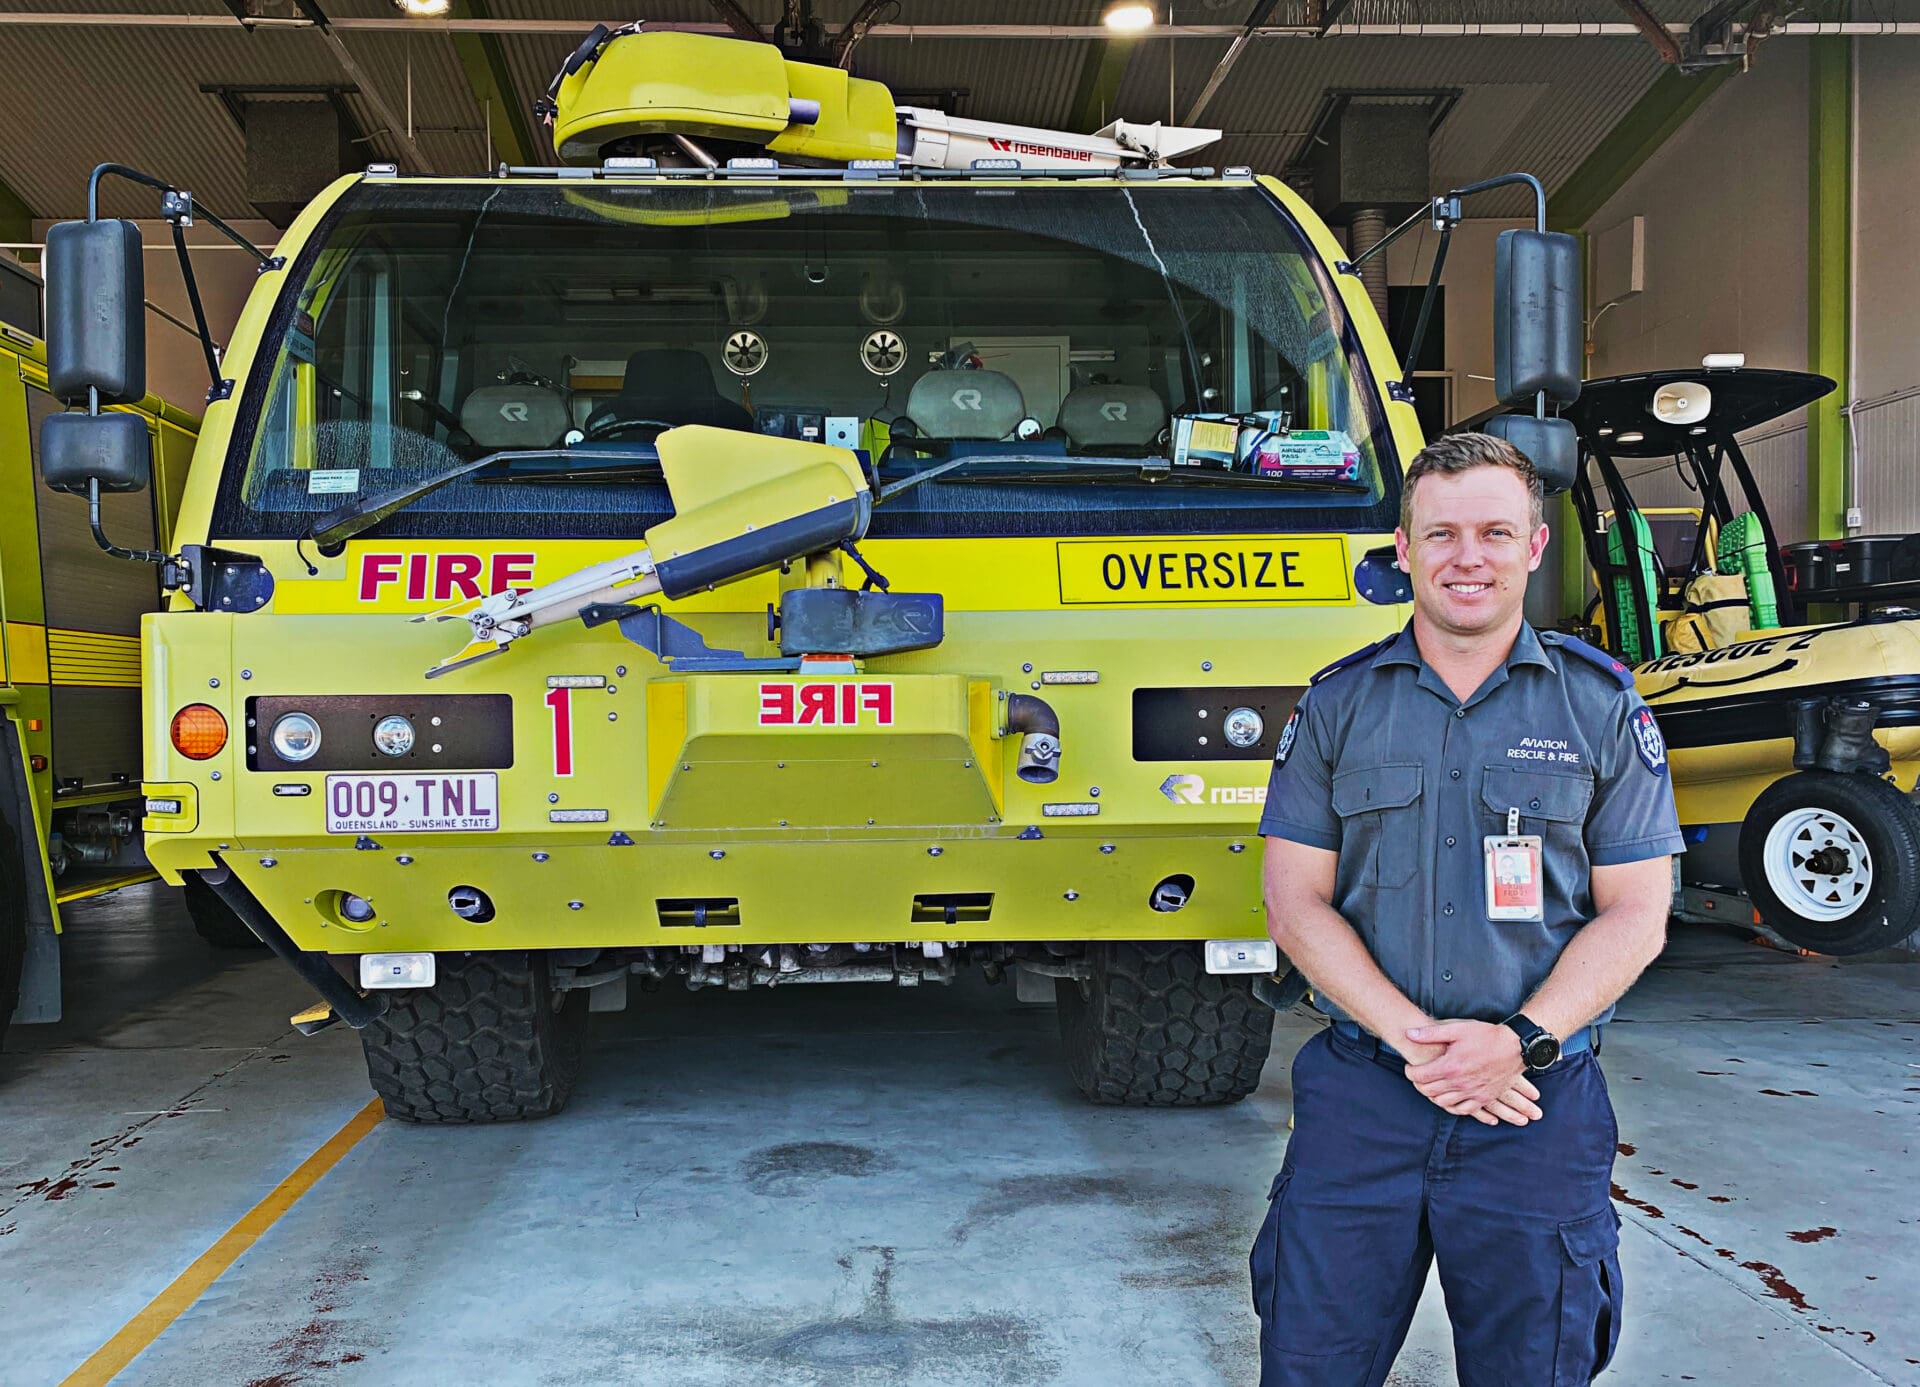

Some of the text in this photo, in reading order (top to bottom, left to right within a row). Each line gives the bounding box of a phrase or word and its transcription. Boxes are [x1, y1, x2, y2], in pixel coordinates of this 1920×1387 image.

[1014, 143, 1092, 162] rosenbauer
[359, 552, 536, 602] FIRE
[1102, 551, 1305, 590] OVERSIZE
[1640, 632, 1822, 675] RESCUE 2
[544, 687, 574, 777] 1
[1520, 738, 1567, 750] AVIATION
[1507, 748, 1579, 763] RESCUE & FIRE
[415, 779, 490, 816] TNL
[335, 821, 398, 830] QUEENSLAND
[408, 819, 456, 828] SUNSHINE
[462, 818, 490, 827] STATE
